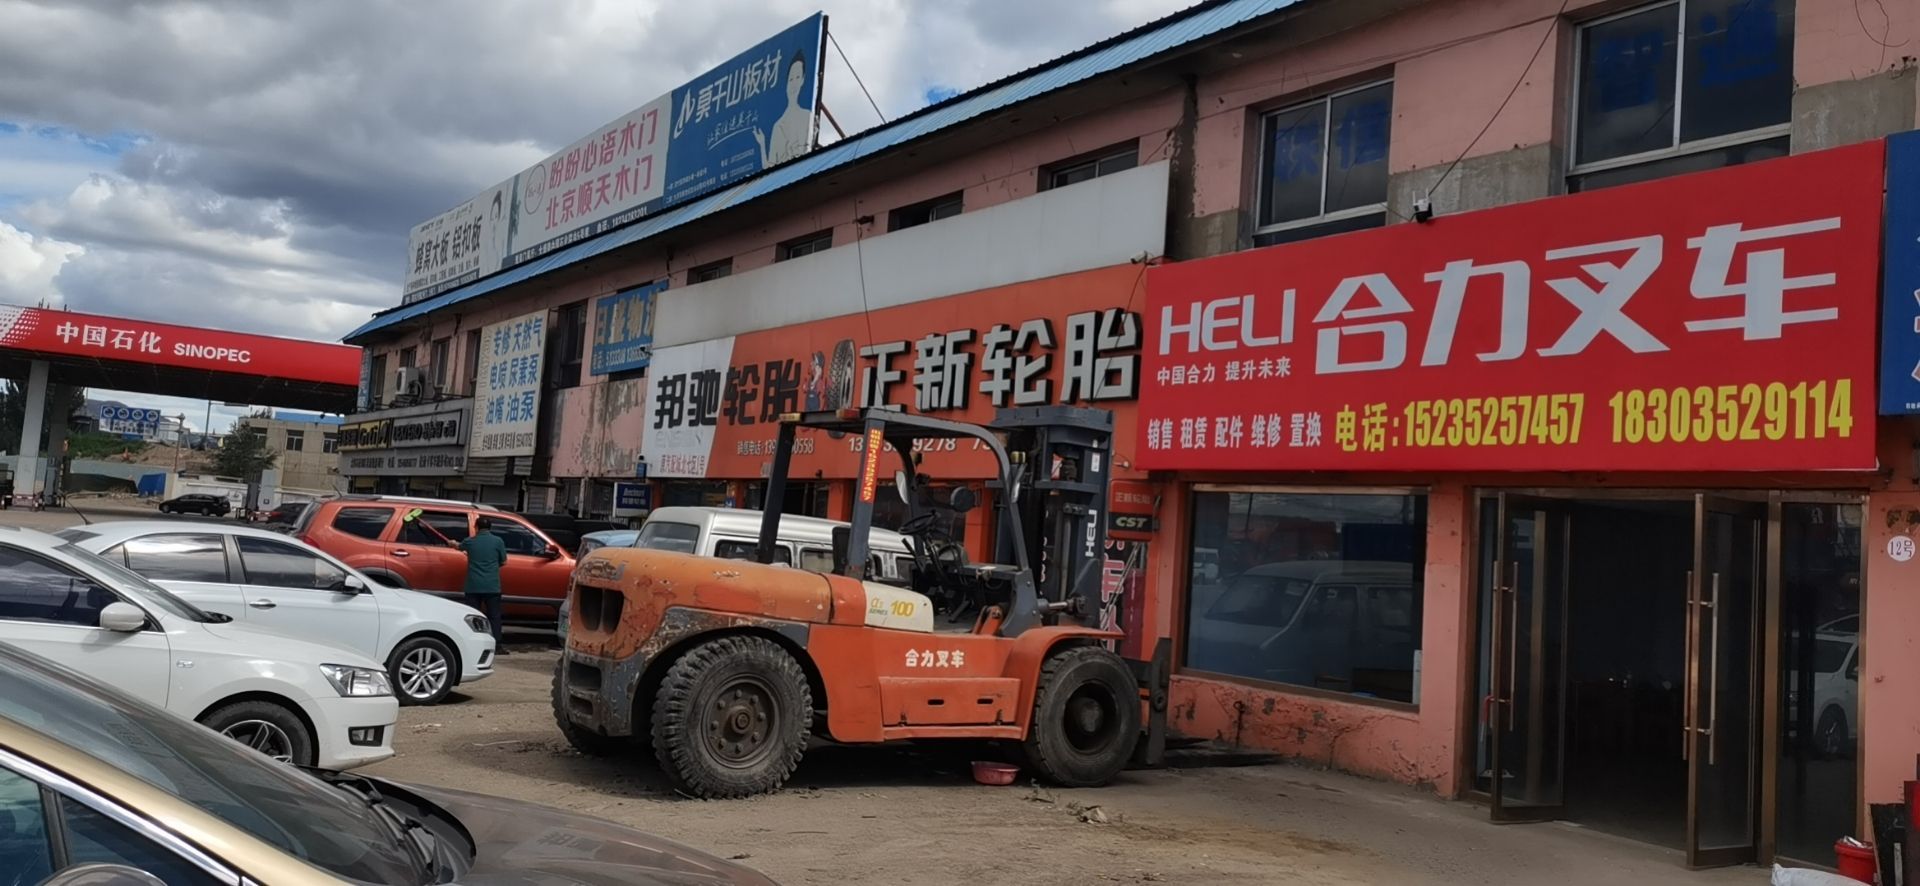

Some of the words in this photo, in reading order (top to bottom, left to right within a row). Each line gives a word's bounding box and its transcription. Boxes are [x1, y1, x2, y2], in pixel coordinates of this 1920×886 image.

[695, 48, 782, 123] 莫干山板材
[548, 108, 659, 190] 盼盼心语木门
[544, 153, 653, 231] 北京顺天木门
[414, 231, 450, 274] 蜂窝大板
[1158, 288, 1297, 356] HELI
[1312, 216, 1842, 376] 合力叉车
[56, 321, 162, 355] 中国石化
[173, 342, 251, 364] SINOPEC
[494, 326, 511, 356] 专修
[512, 317, 543, 352] 天然气
[509, 353, 540, 388] 尿素泵
[859, 307, 1142, 413] 正新轮胎
[1156, 362, 1216, 387] 中国合力
[1224, 355, 1292, 382] 提升未来
[506, 390, 535, 422] 油泵
[654, 358, 802, 430] 邦驰轮胎
[1147, 417, 1174, 450] 销售
[1180, 416, 1208, 449] 租赁
[1214, 414, 1244, 448] 配件
[1250, 413, 1282, 448] 维修
[1289, 411, 1322, 447] 置换
[1609, 378, 1854, 445] 18303529114
[1085, 509, 1098, 558] HELI
[1115, 516, 1147, 529] CST
[1889, 540, 1913, 558] 12号
[890, 600, 914, 617] 100
[904, 648, 965, 668] 合力叉车
